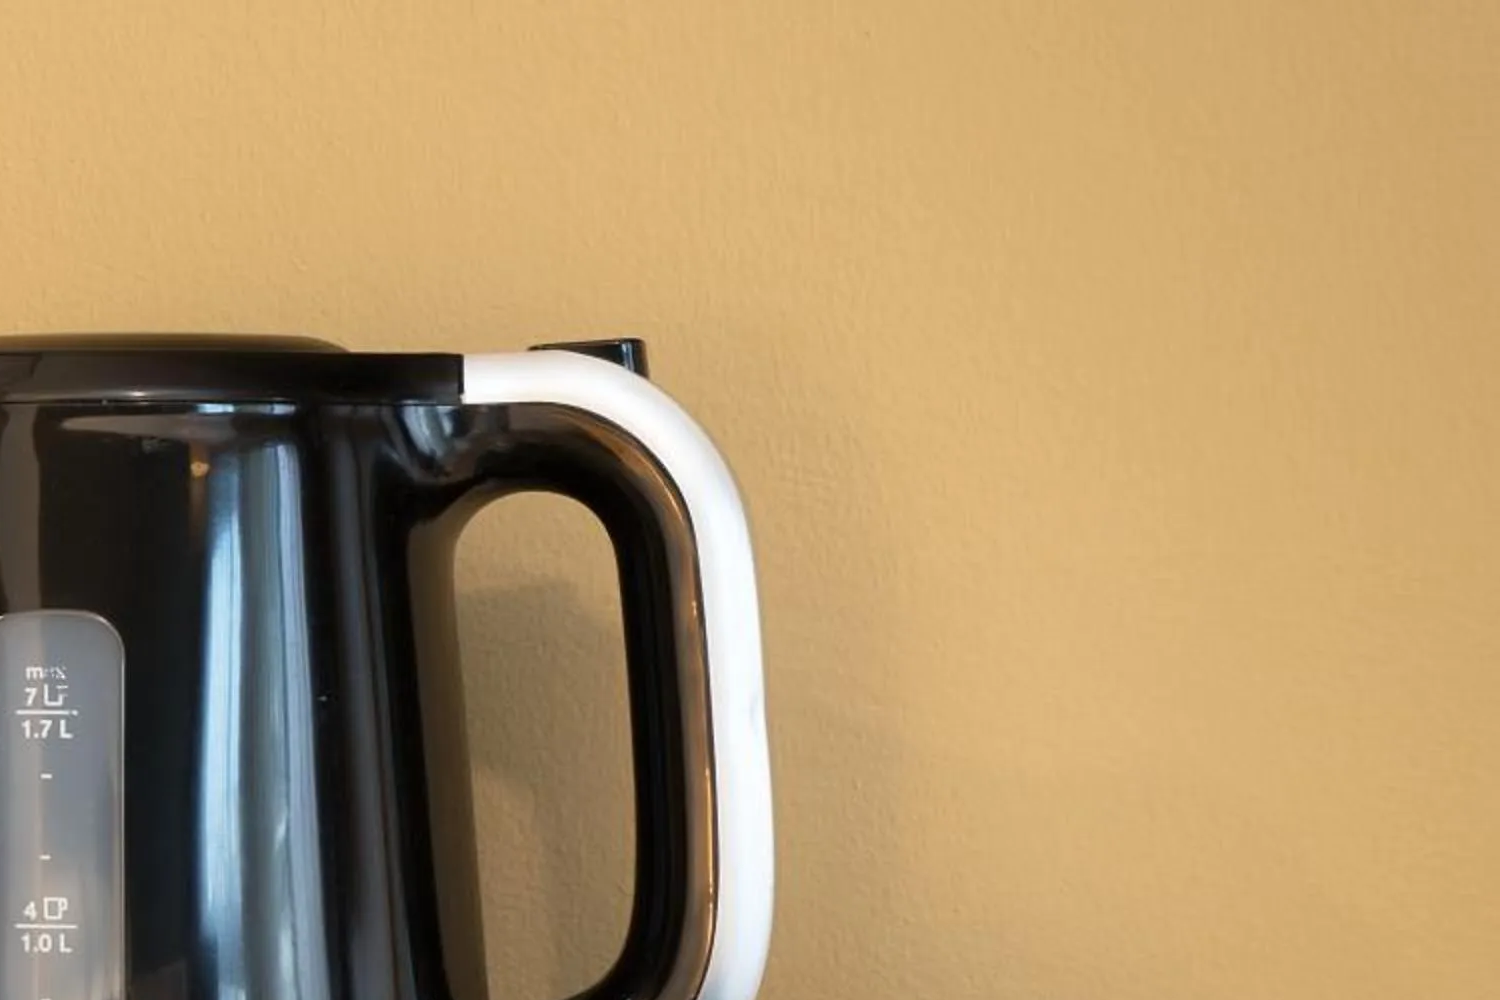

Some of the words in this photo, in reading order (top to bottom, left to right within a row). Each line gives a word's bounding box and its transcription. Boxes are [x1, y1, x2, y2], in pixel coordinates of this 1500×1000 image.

[24, 686, 37, 706] 7
[21, 720, 53, 738] 1.7
[60, 720, 73, 738] L
[24, 901, 37, 920] 4
[21, 933, 53, 953] 1.0
[59, 933, 73, 953] L
